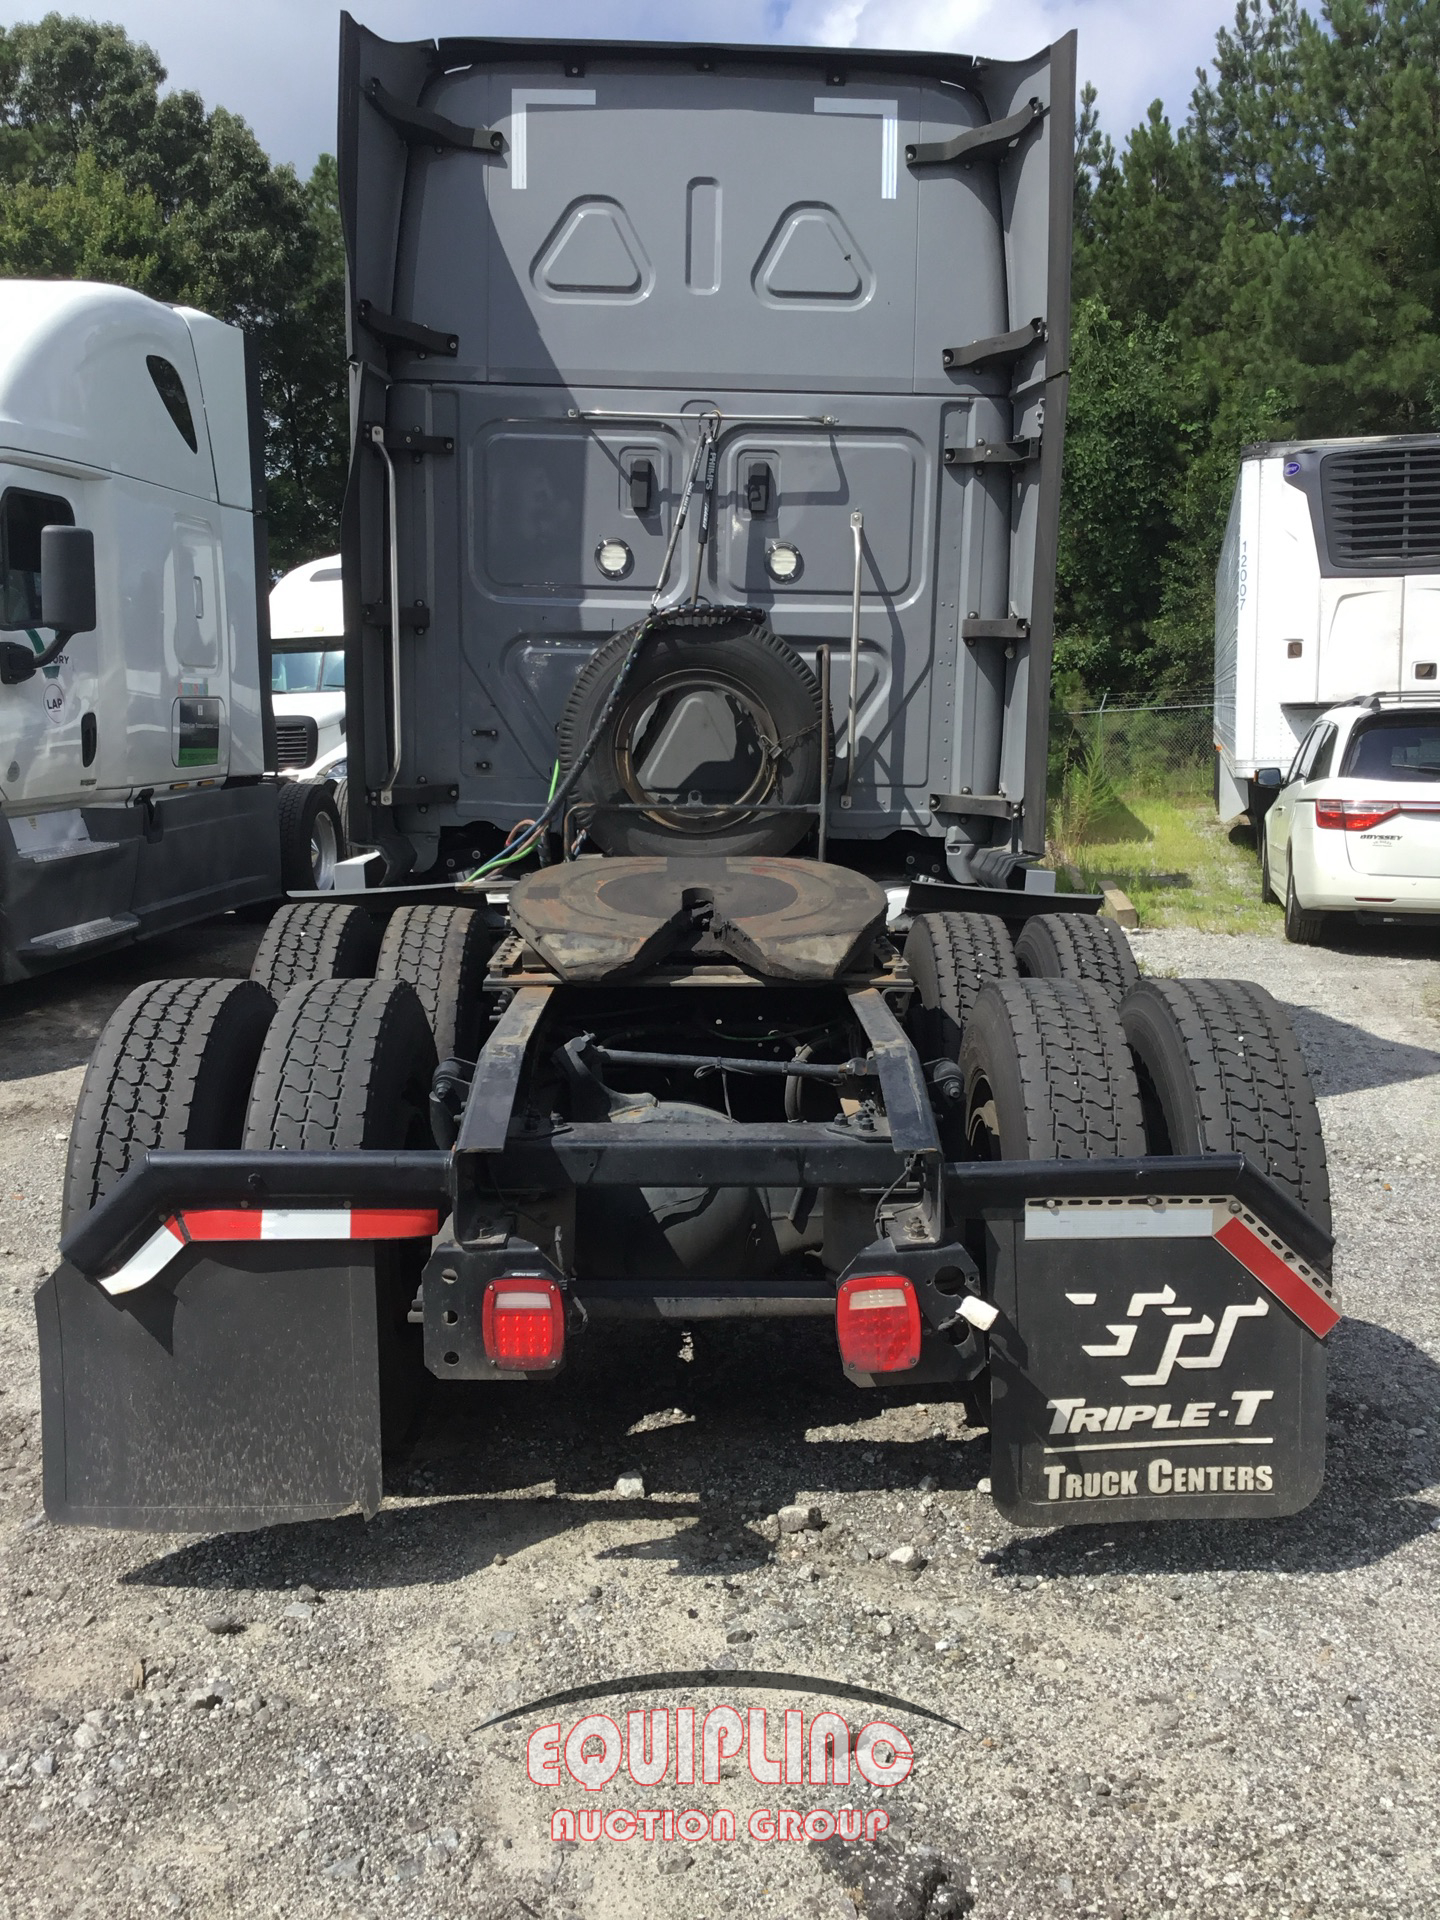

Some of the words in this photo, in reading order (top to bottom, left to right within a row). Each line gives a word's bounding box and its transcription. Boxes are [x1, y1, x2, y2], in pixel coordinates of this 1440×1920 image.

[1240, 541, 1248, 611] 12007
[46, 698, 63, 710] LAP
[1045, 1390, 1275, 1435] TRIPLE-T
[1043, 1465, 1139, 1500] TRUCK
[1147, 1458, 1274, 1495] CENTERS
